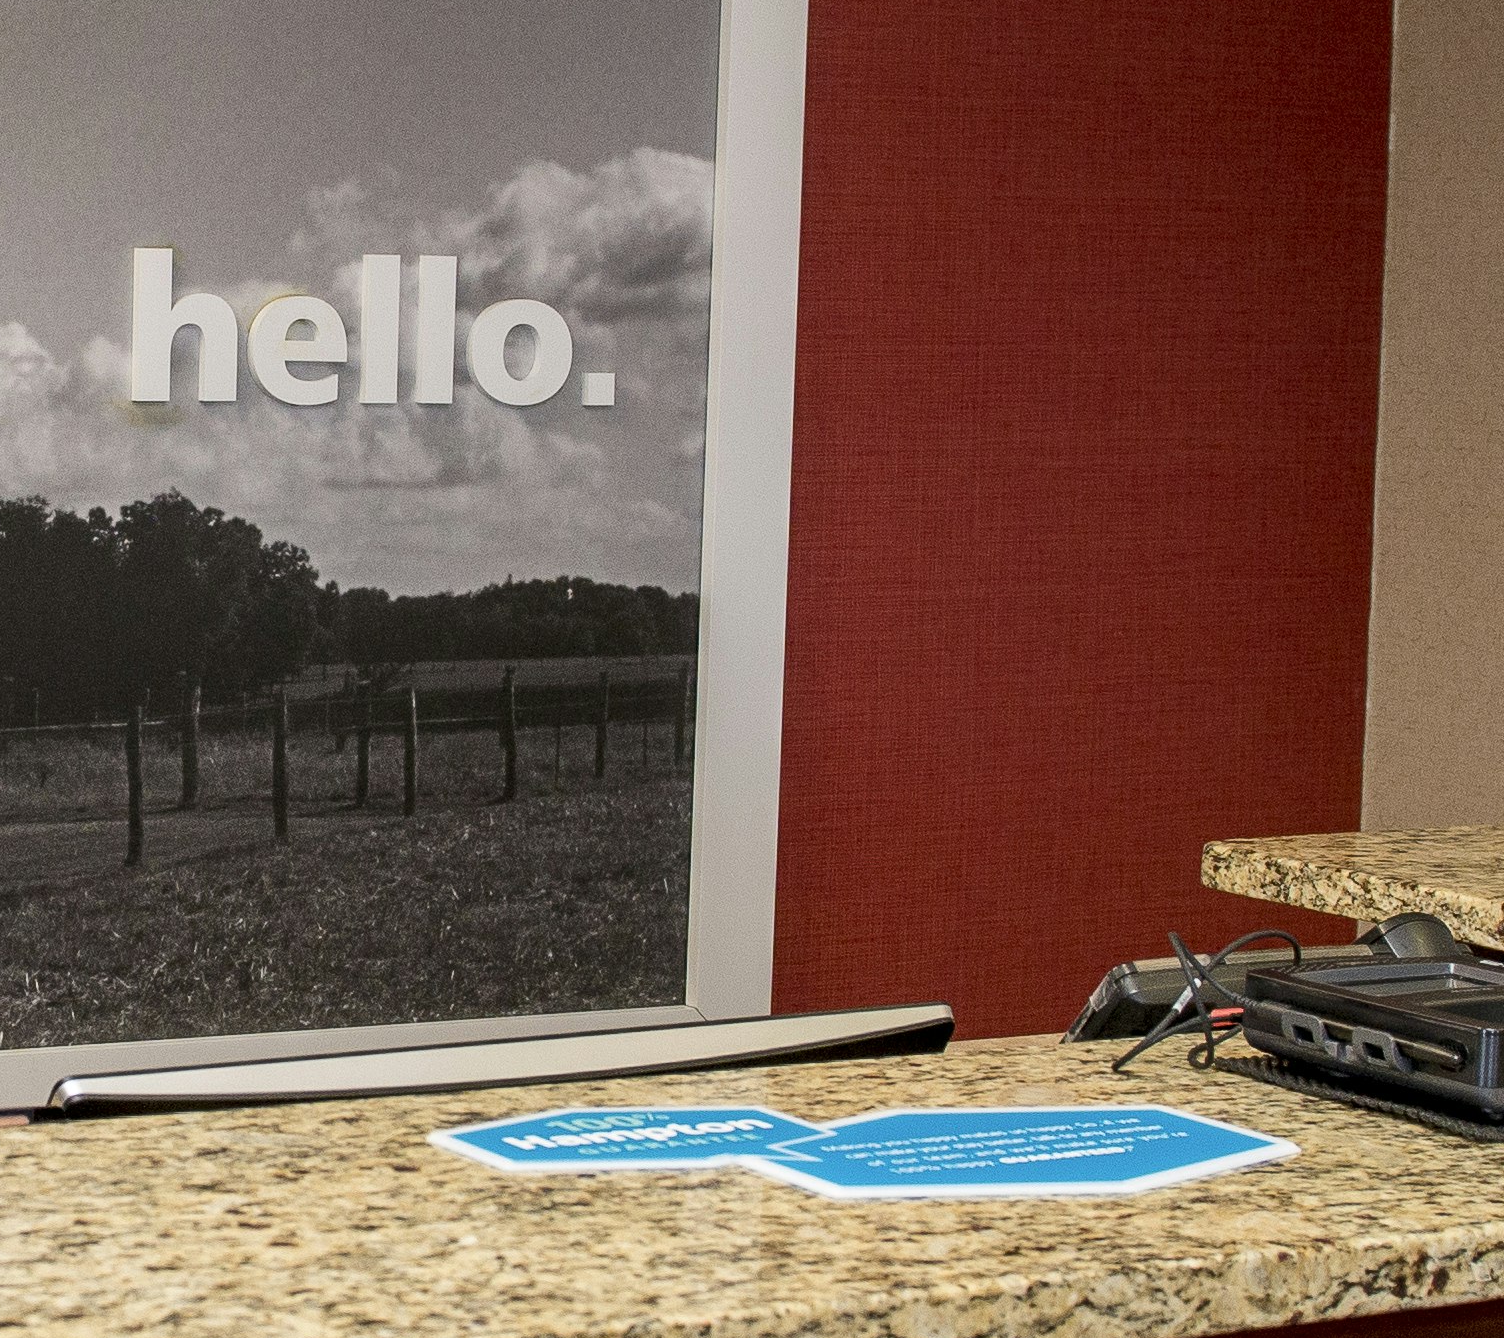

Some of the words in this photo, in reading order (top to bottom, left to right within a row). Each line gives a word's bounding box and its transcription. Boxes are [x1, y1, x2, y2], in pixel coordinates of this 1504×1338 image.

[131, 247, 615, 406] hello.
[502, 1117, 775, 1151] Hampton
[547, 1111, 670, 1132] 100%
[578, 1134, 765, 1155] GUARANTEE
